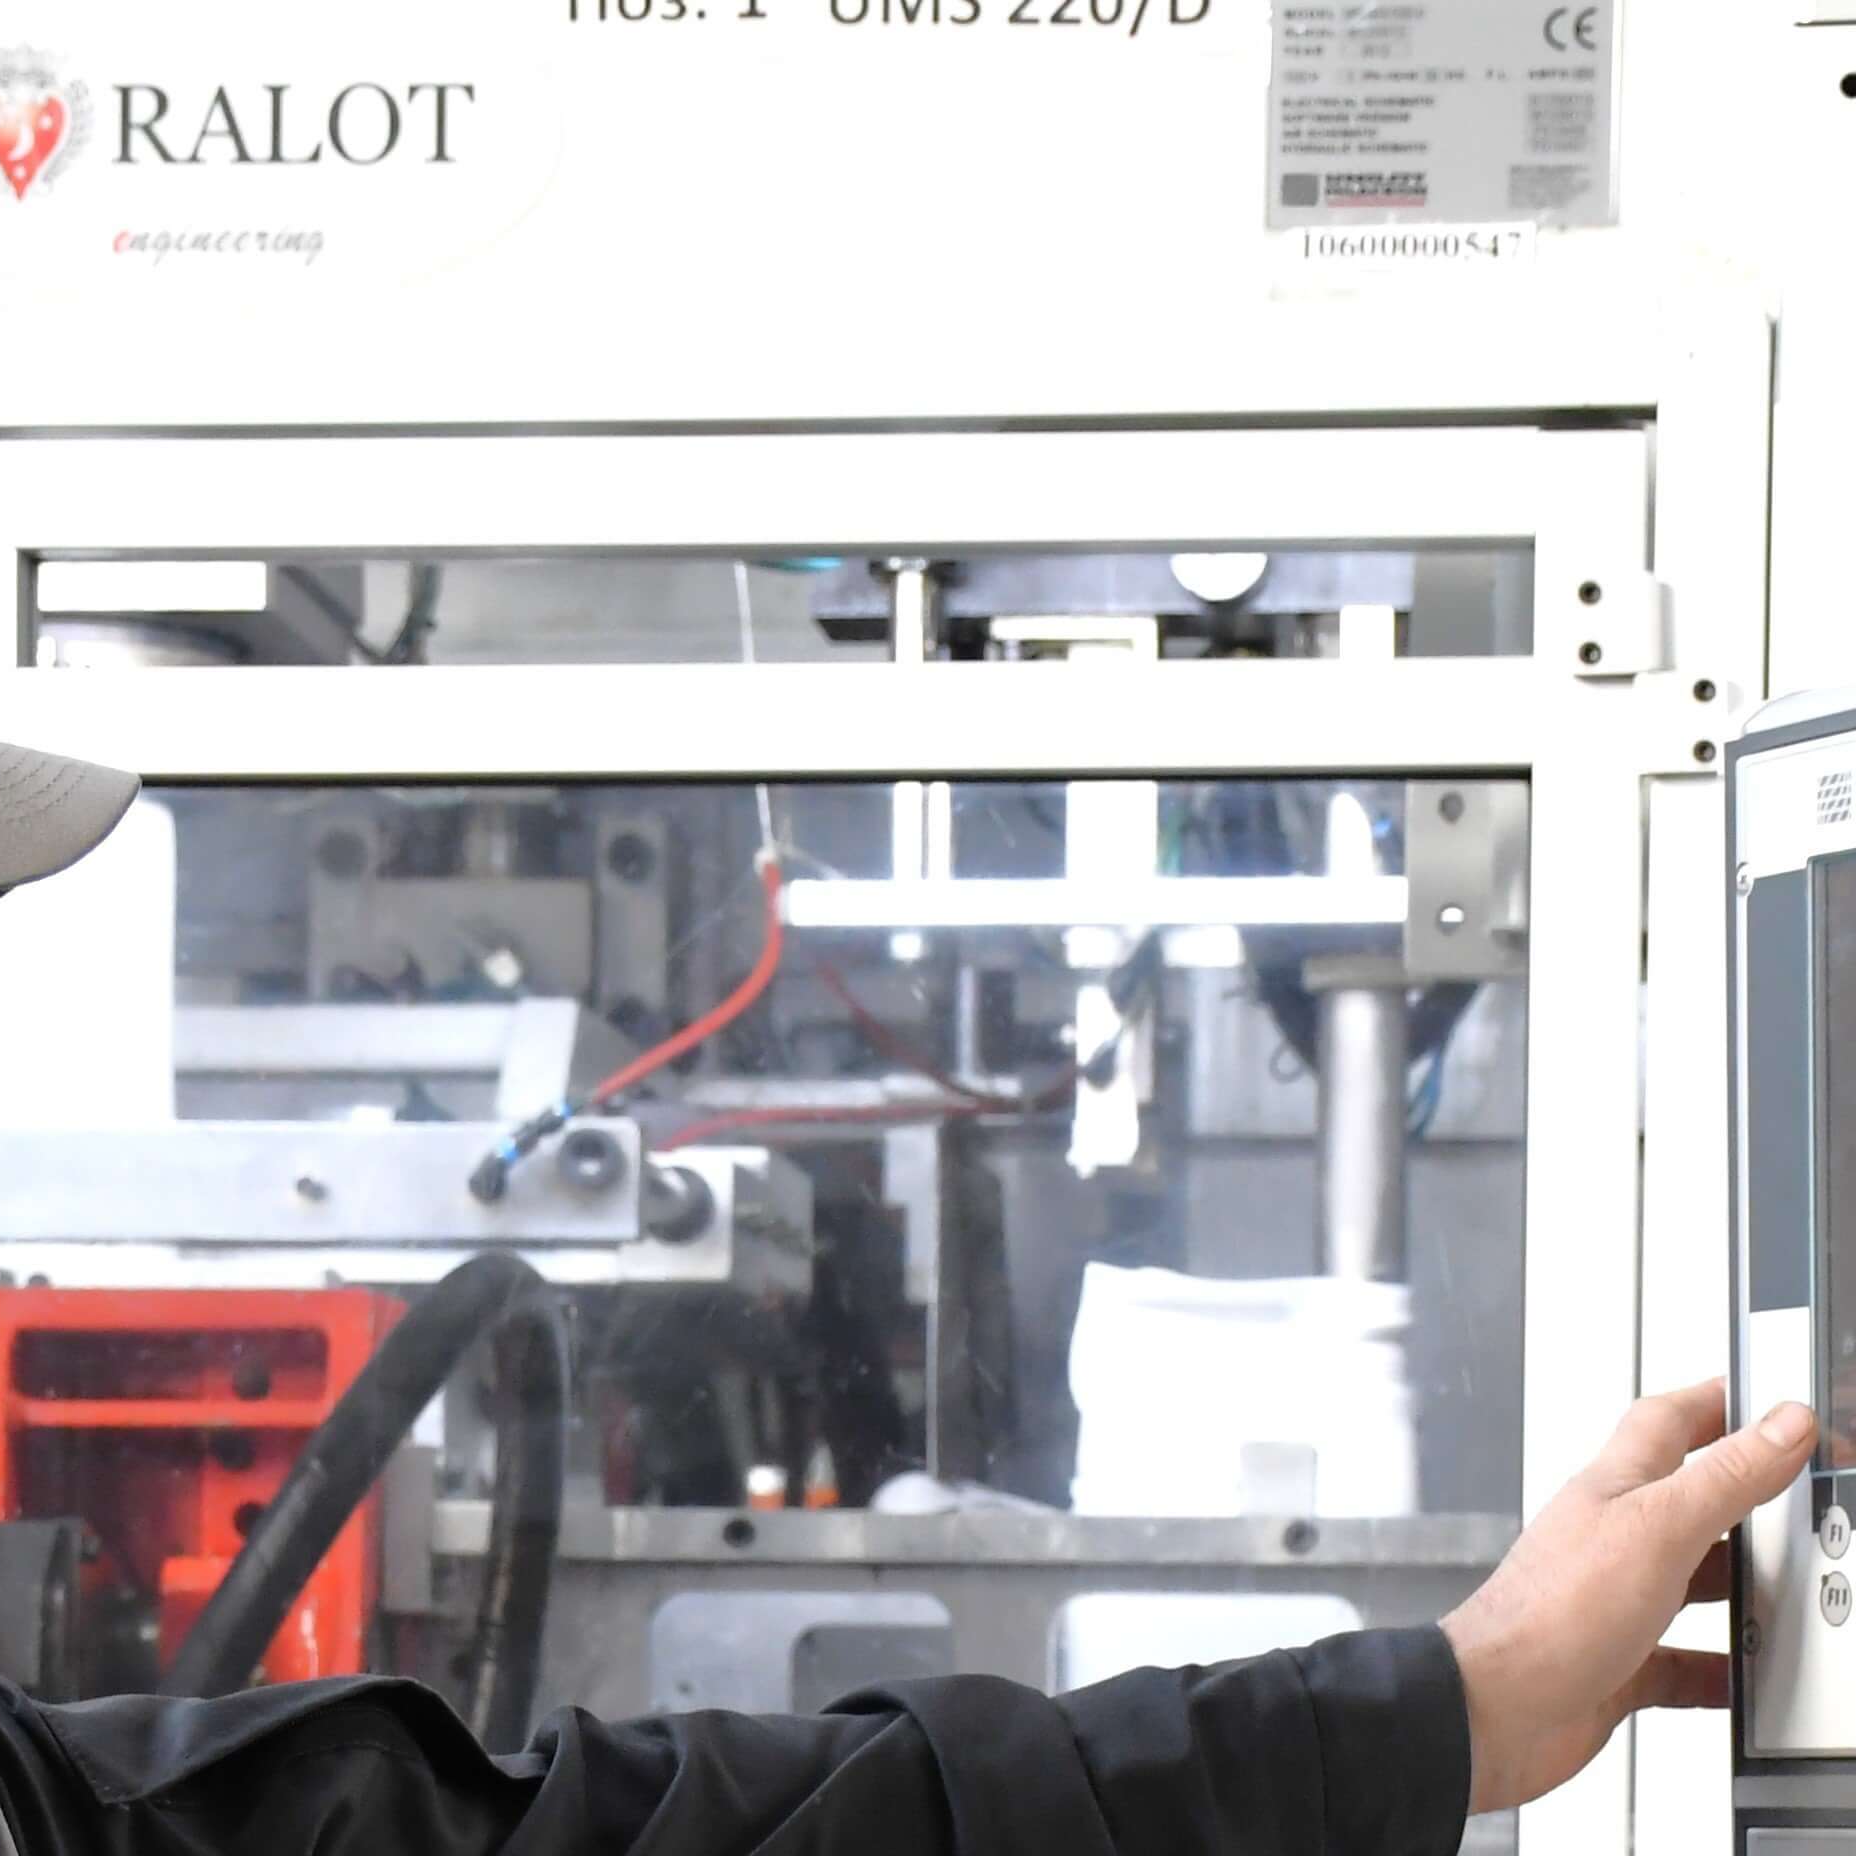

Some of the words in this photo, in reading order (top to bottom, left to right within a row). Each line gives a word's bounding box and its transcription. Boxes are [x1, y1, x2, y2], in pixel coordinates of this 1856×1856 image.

[111, 81, 476, 166] RALOT
[112, 225, 325, 266] engineering
[1830, 1524, 1843, 1543] F1
[1827, 1587, 1848, 1607] F11
